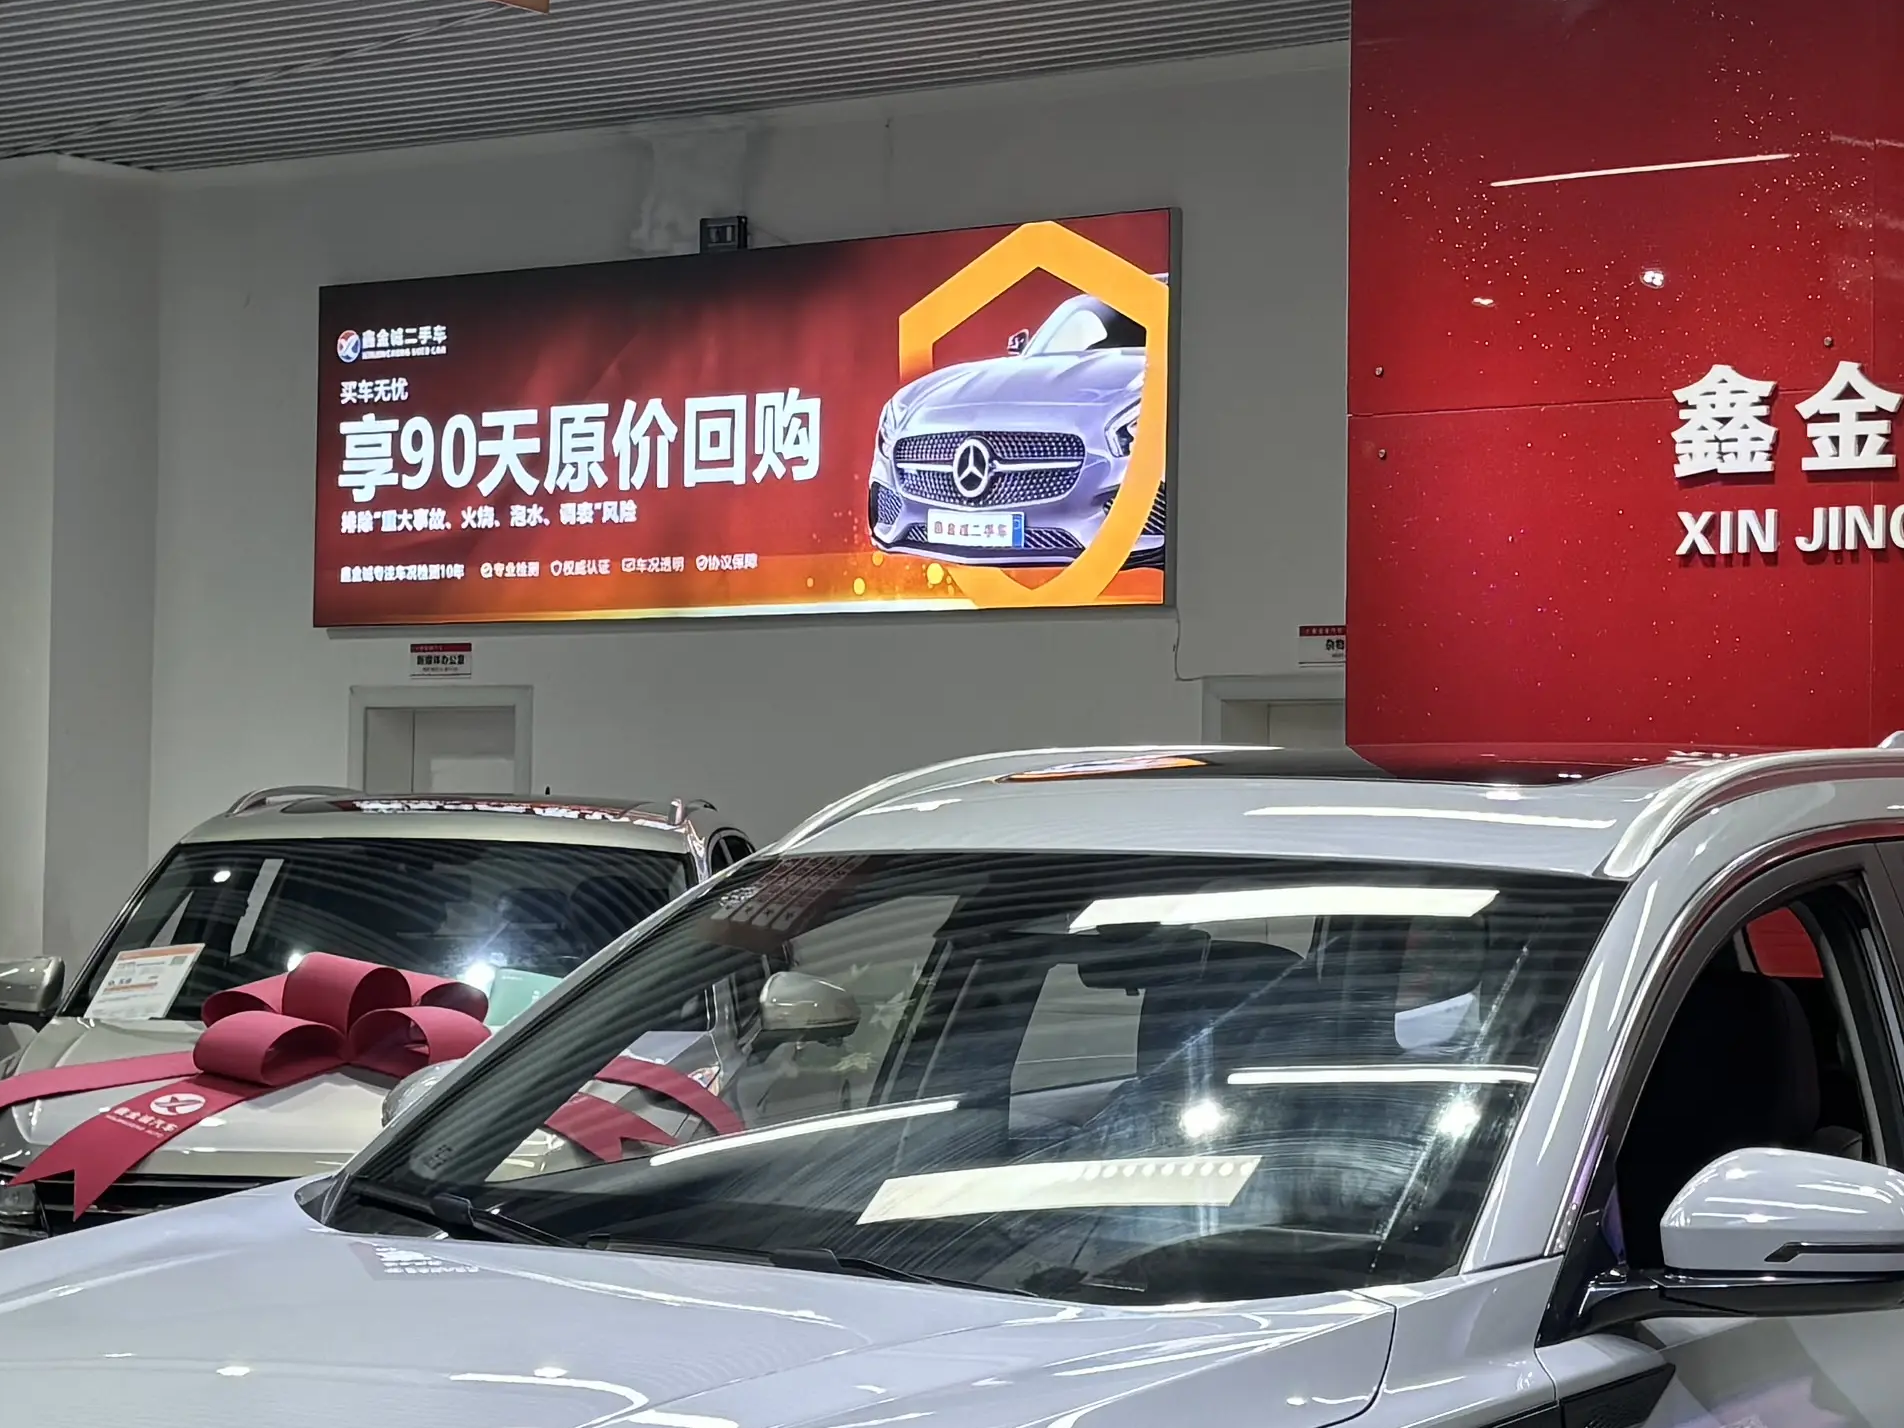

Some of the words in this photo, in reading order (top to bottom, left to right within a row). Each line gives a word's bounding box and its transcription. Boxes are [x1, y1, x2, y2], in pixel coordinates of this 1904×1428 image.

[339, 377, 409, 405] 买车无忧
[337, 386, 822, 503] 享90天原价回购
[1676, 507, 1778, 556] XIN
